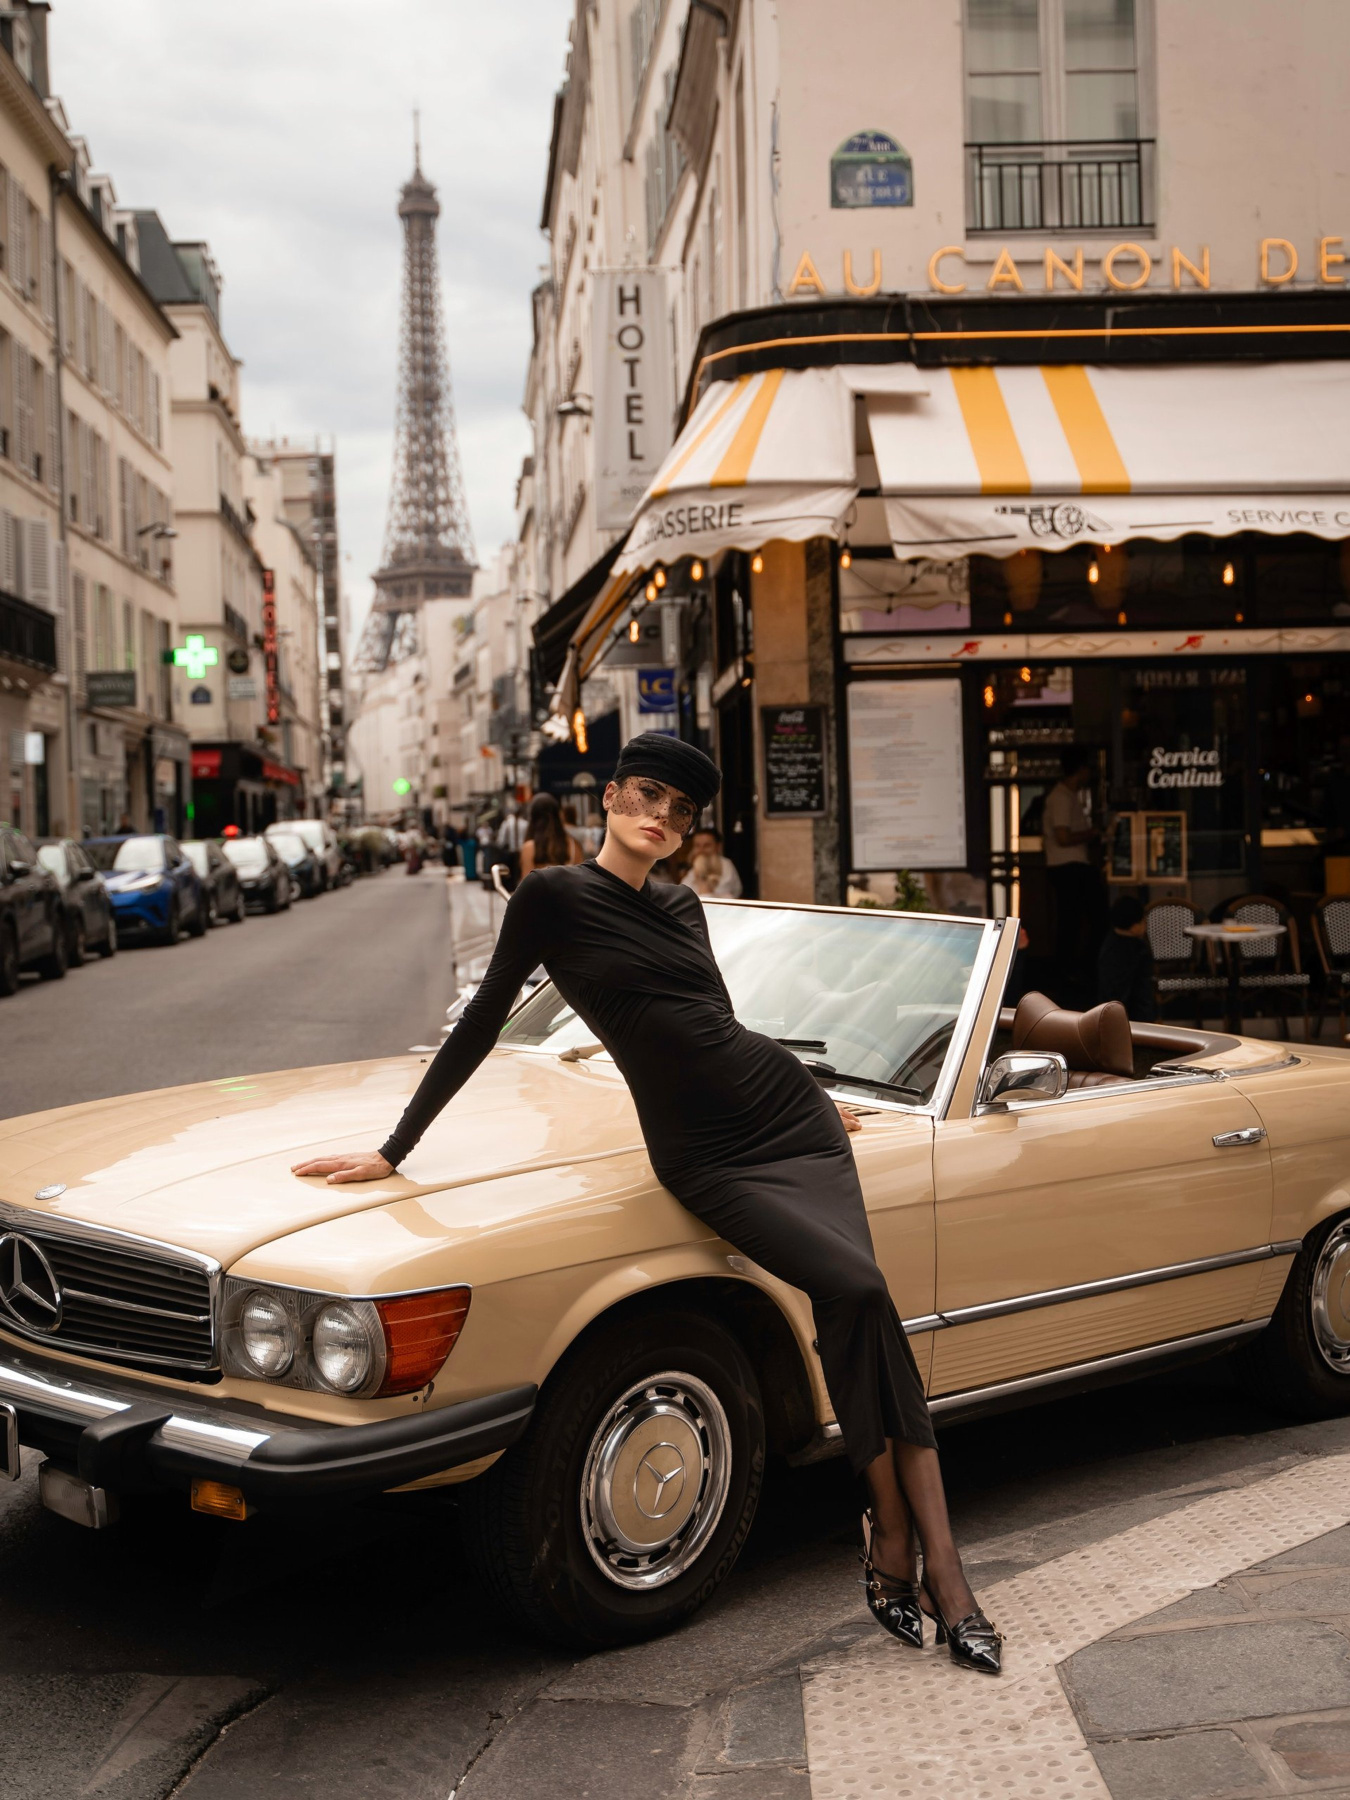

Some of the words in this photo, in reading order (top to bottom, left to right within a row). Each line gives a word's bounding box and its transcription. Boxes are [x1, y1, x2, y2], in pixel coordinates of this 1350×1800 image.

[789, 249, 882, 297] AU
[928, 242, 1210, 294] CANON
[1261, 236, 1345, 284] DE
[616, 284, 645, 460] HOTEL
[643, 503, 744, 545] ASSERIE
[1227, 509, 1328, 527] SERVICE
[1149, 746, 1220, 768] Service
[1147, 767, 1226, 789] Continu
